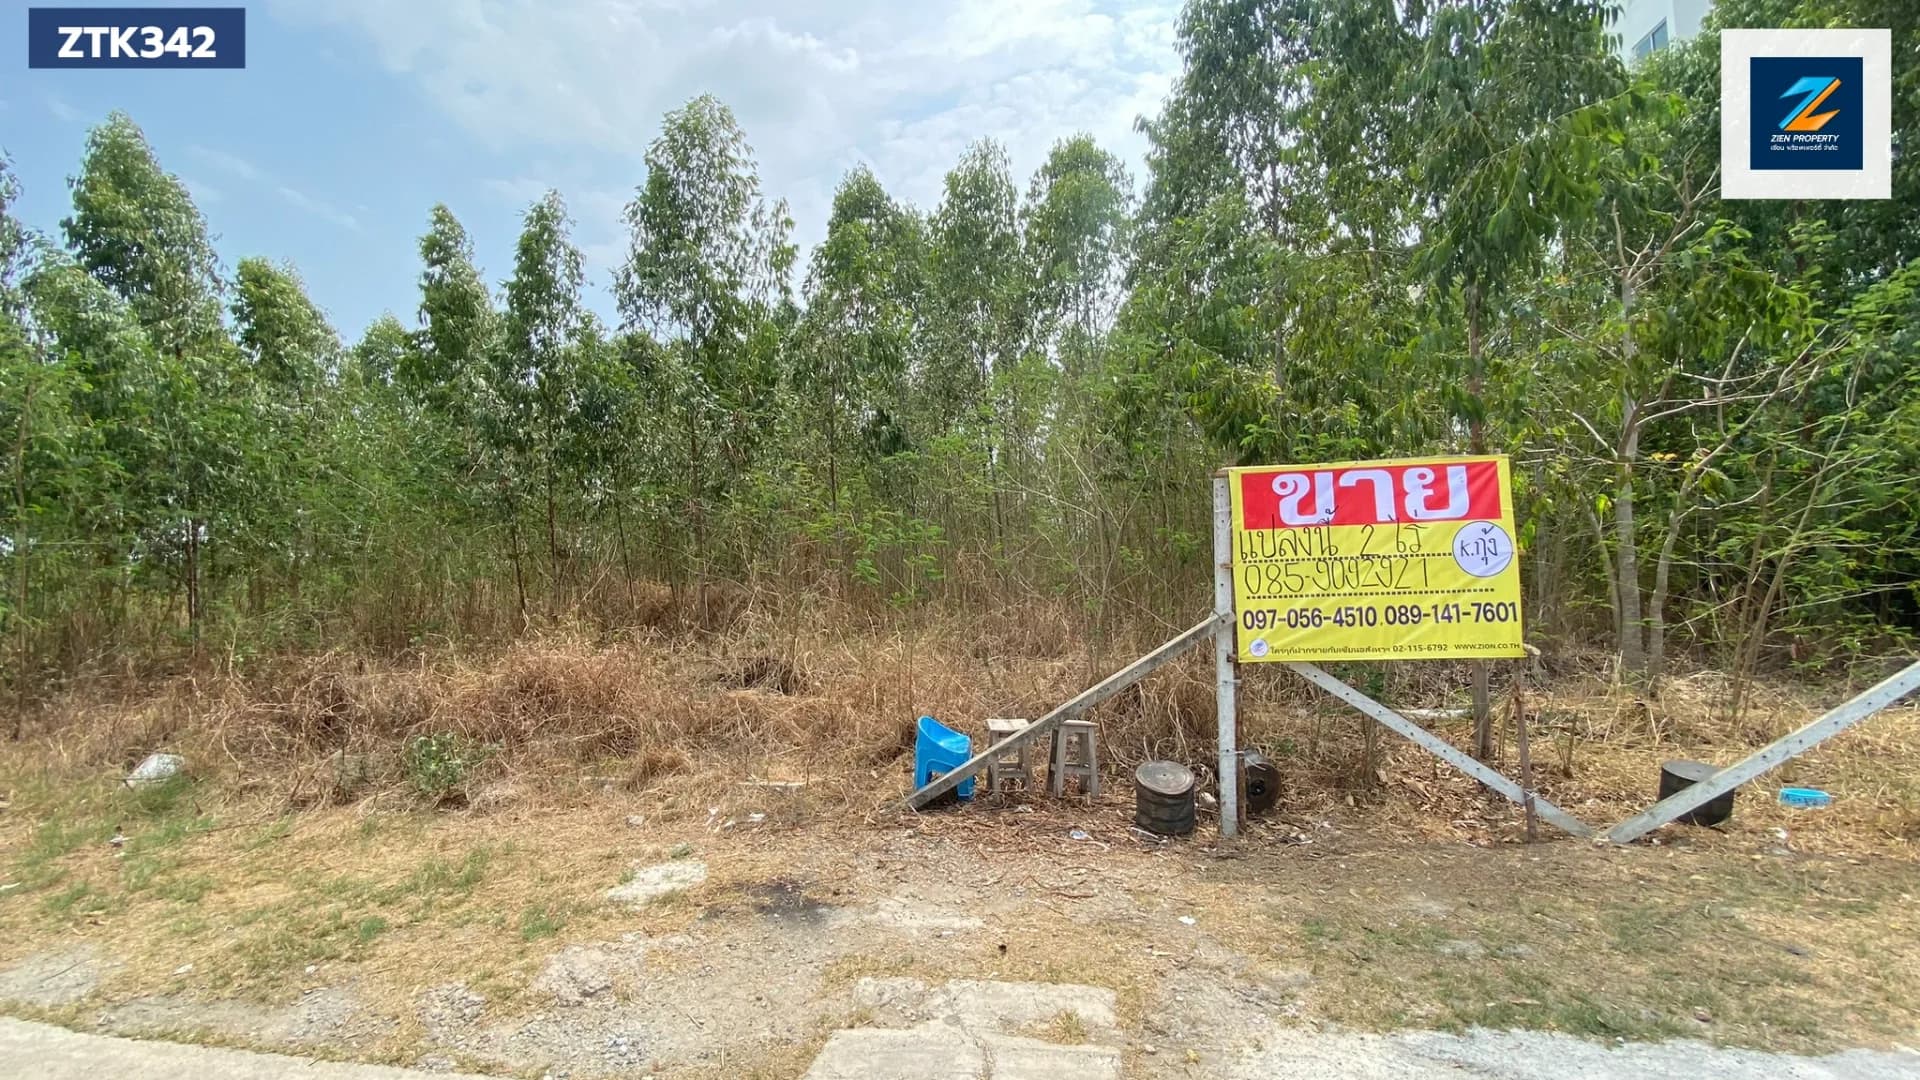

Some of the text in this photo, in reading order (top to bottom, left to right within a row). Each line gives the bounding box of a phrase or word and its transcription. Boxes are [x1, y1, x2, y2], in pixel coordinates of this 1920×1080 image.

[1272, 465, 1470, 525] ขาย
[1359, 523, 1379, 556] 2
[1392, 643, 1449, 653] 02-115-6792
